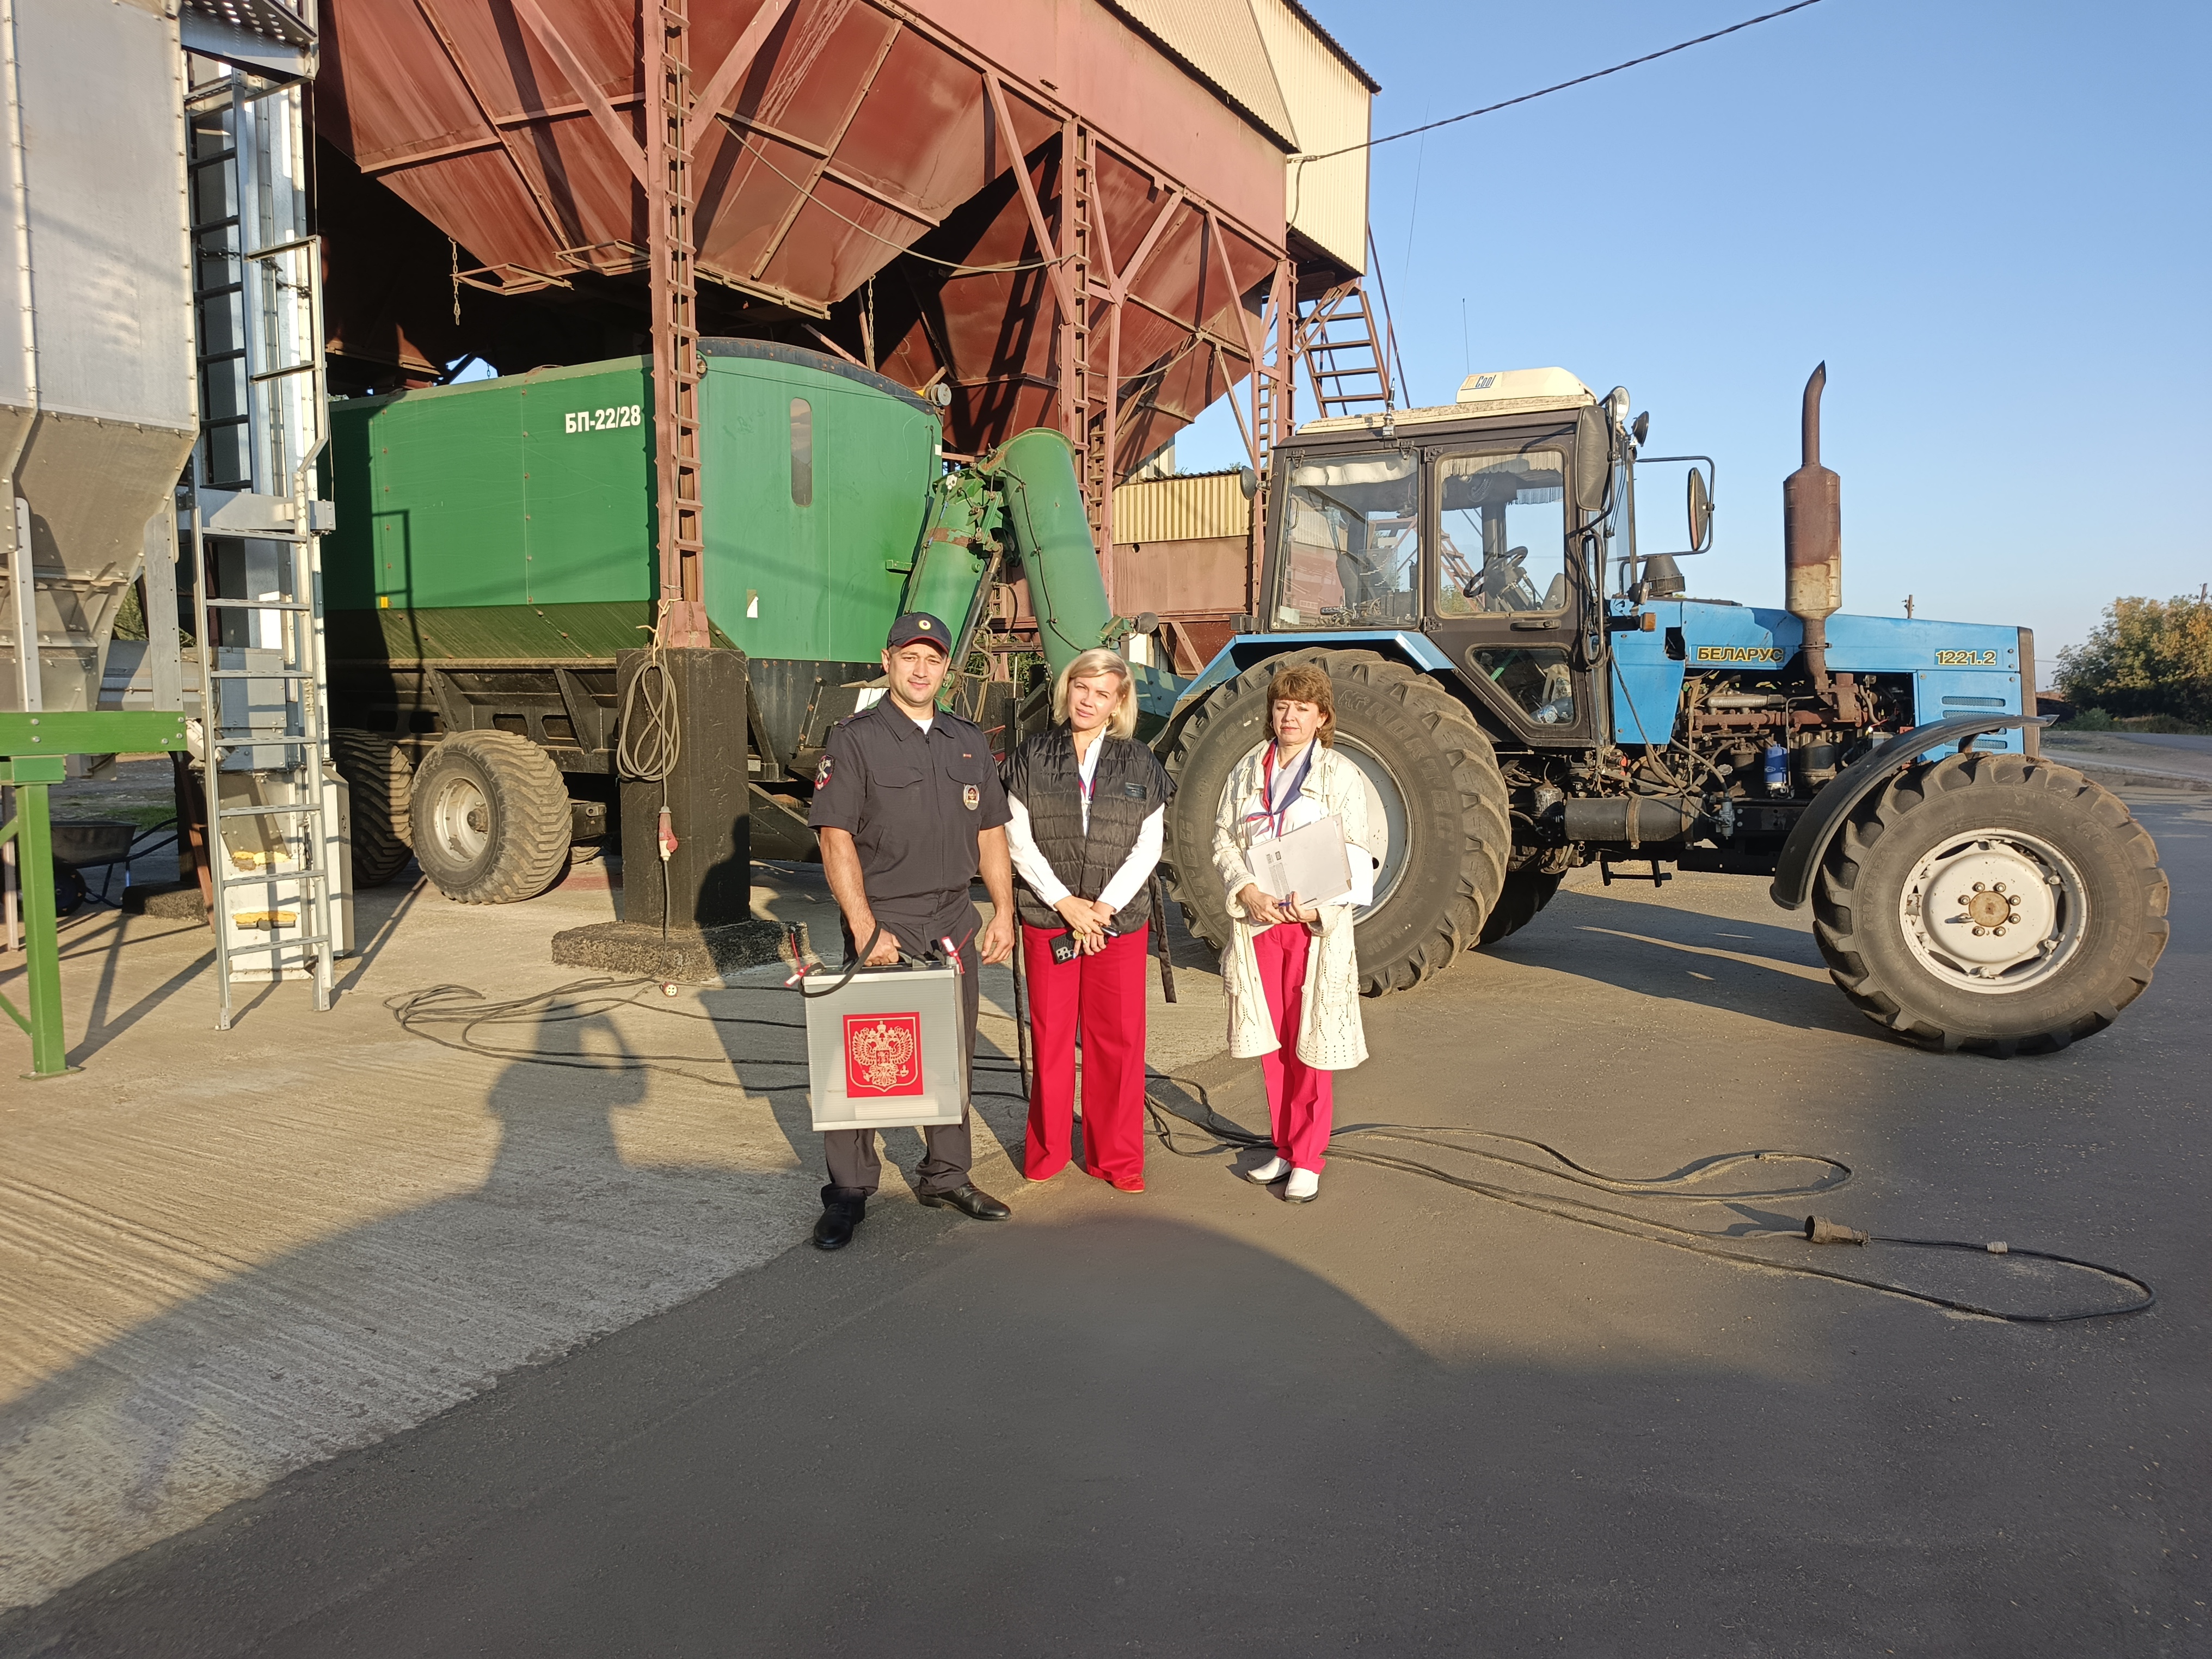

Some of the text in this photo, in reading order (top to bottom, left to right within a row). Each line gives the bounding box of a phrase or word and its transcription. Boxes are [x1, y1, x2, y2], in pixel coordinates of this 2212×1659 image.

[565, 404, 641, 433] БП-22/28
[1697, 646, 1784, 663] БЕЛАРУС
[1935, 649, 1997, 666] 1221.2
